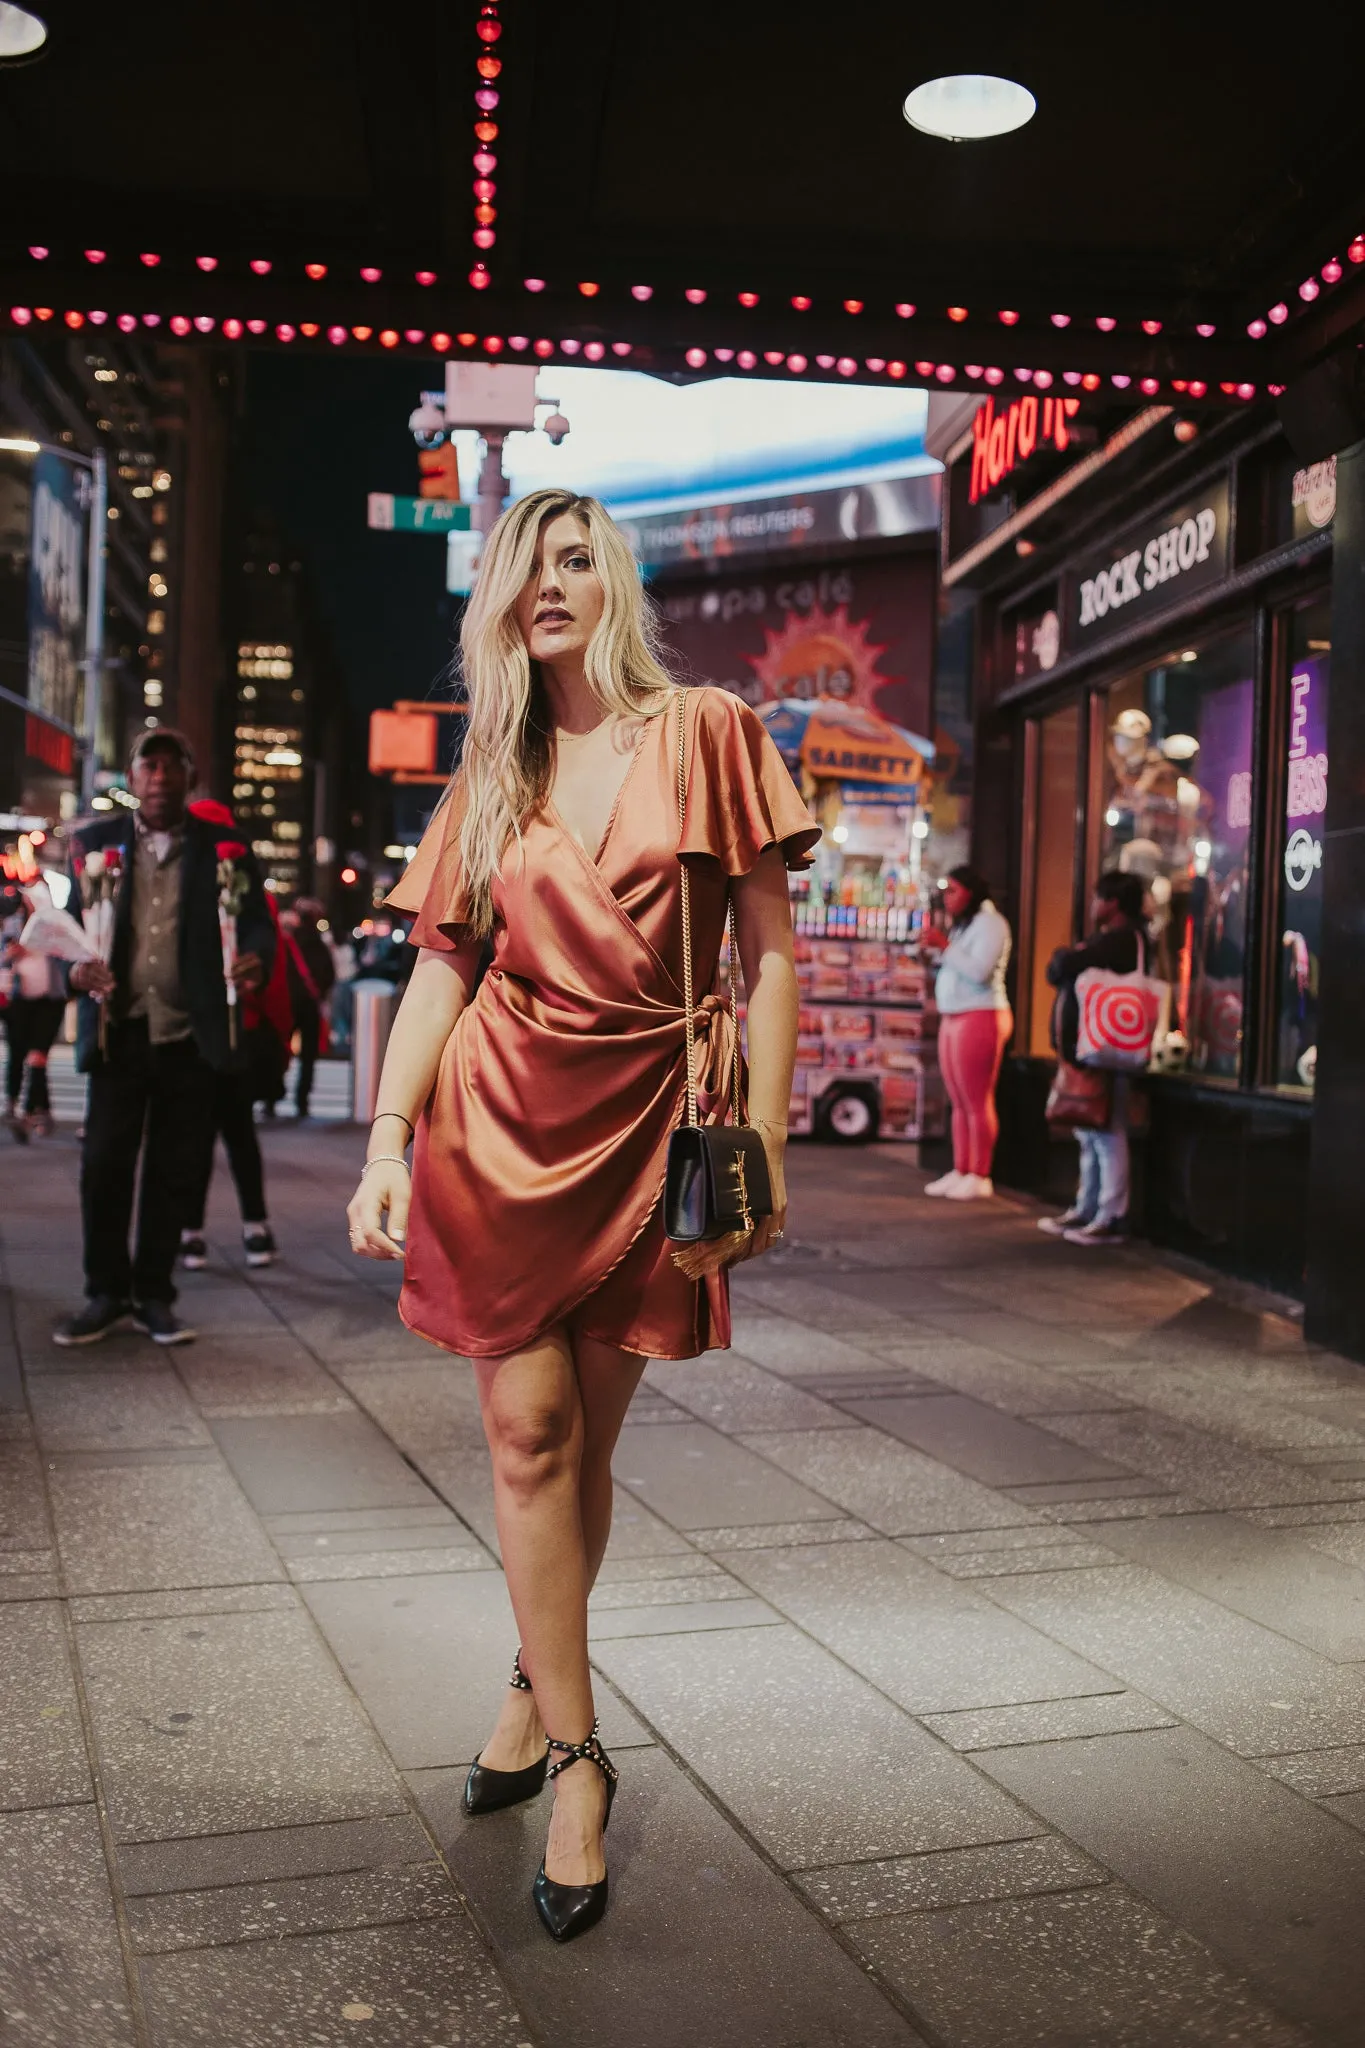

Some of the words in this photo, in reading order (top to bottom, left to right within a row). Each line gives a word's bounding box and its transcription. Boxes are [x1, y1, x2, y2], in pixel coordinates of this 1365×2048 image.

[1079, 549, 1142, 627] ROCK
[1143, 508, 1216, 591] SHOP
[810, 747, 912, 774] SABRETT
